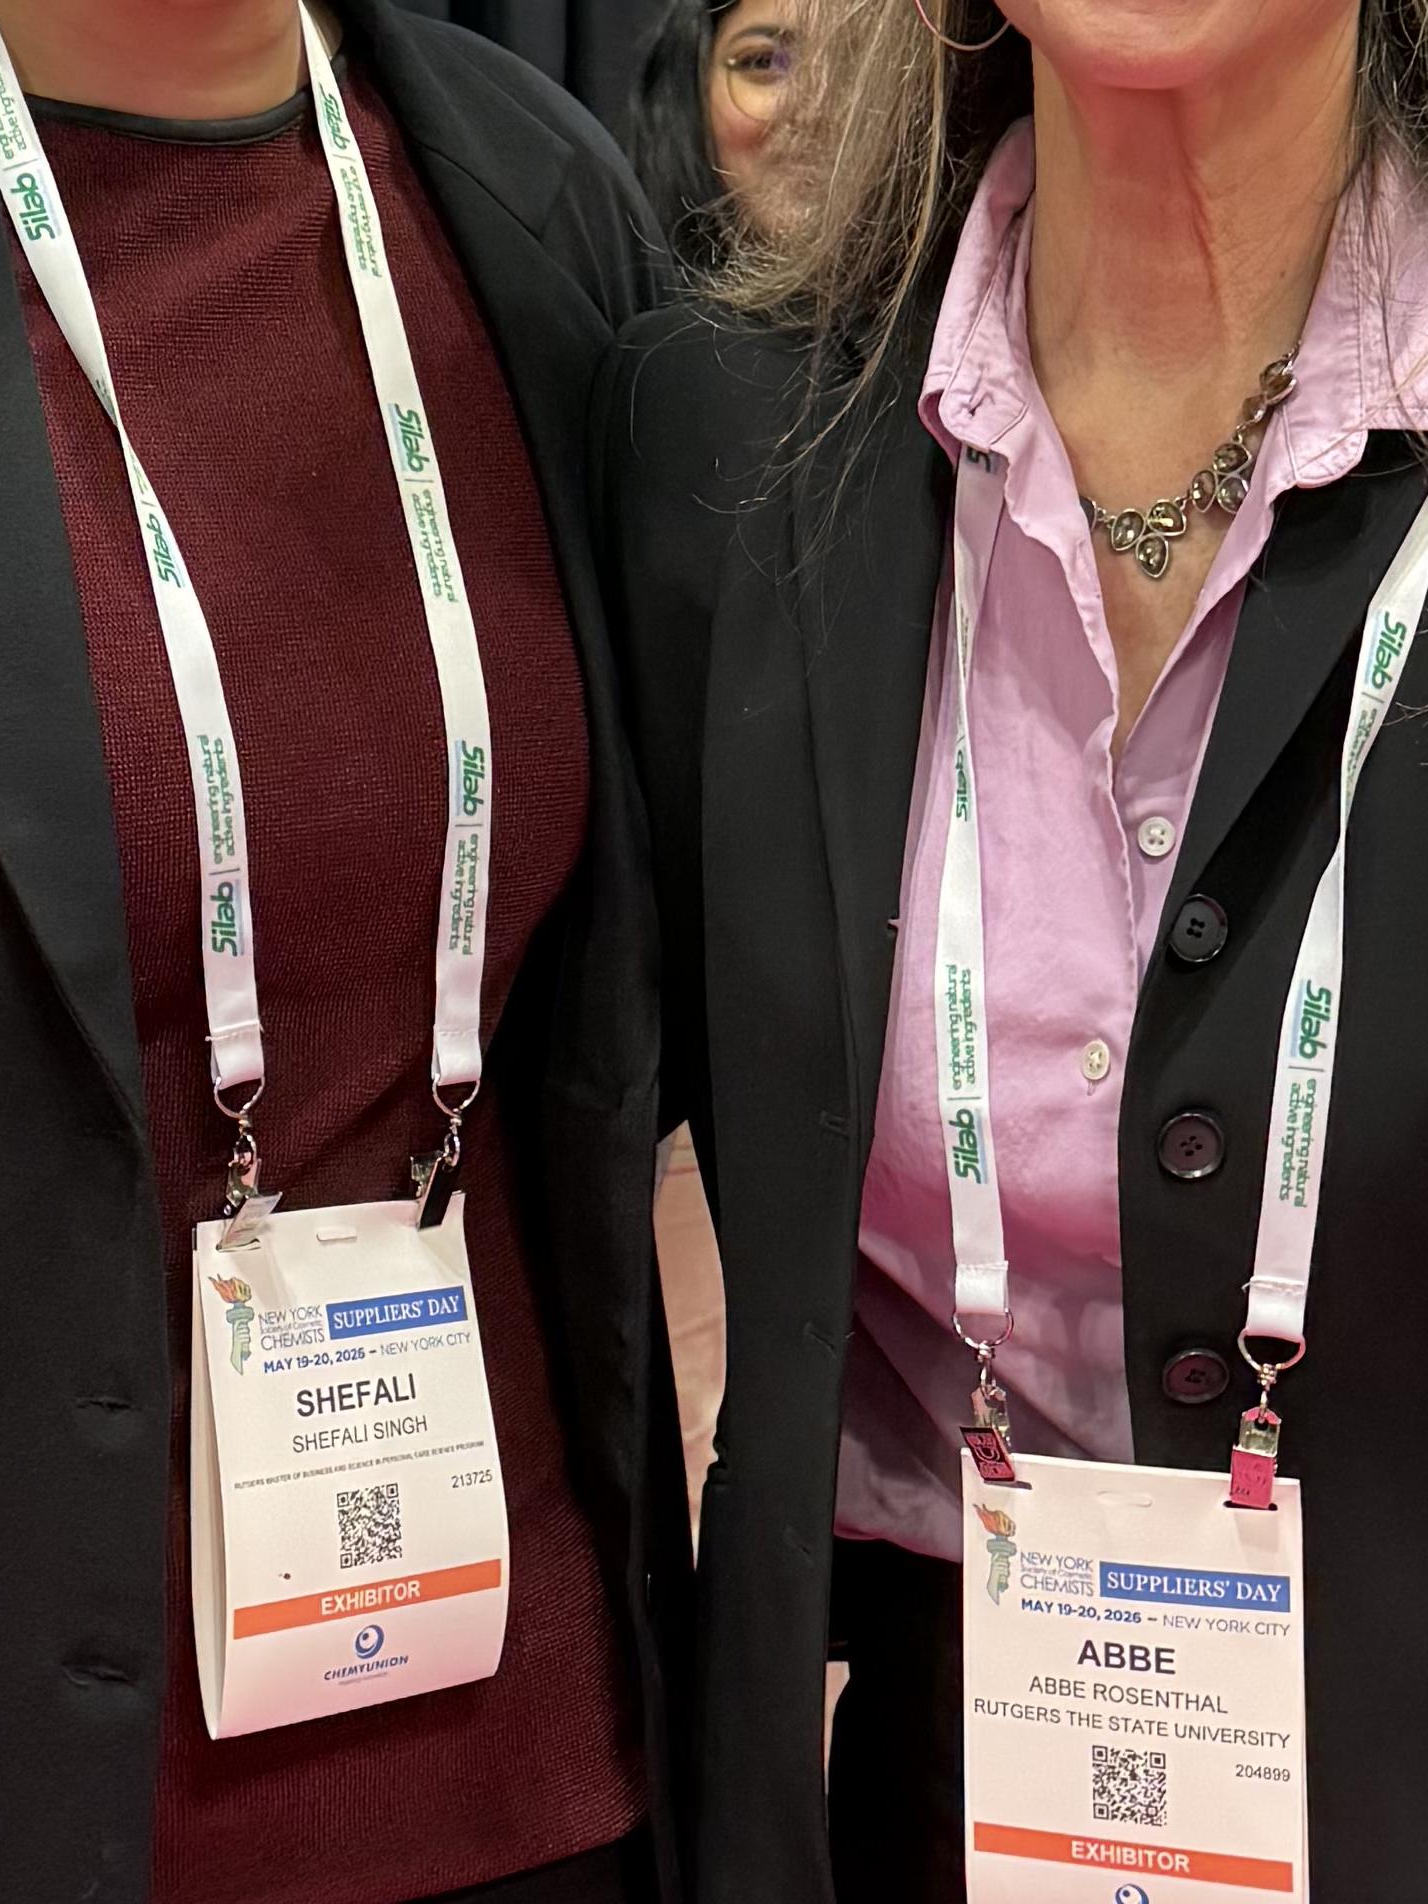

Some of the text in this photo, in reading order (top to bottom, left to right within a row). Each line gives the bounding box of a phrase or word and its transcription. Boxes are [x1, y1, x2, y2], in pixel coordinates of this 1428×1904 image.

[7, 116, 26, 152] active
[10, 172, 56, 242] Silab
[393, 402, 431, 474] Silab
[143, 514, 182, 589] Silab
[1369, 611, 1408, 691] Silab
[461, 738, 485, 817] Silab
[197, 734, 224, 865] engineering natural
[221, 816, 234, 857] active
[454, 839, 468, 878] active
[461, 833, 478, 957] engineering natural
[211, 881, 239, 958] Silab
[945, 964, 967, 1089] engineering natural
[958, 968, 976, 1084] active ingredients
[1299, 979, 1334, 1061] Silab
[952, 1107, 981, 1186] Silab
[1277, 1082, 1305, 1202] active ingredients
[1292, 1078, 1320, 1211] engineering natural
[258, 1304, 322, 1327] NEW YORK
[332, 1295, 460, 1330] SUPPLIERS' DAY
[261, 1328, 325, 1351] CHEMISTS
[264, 1358, 293, 1374] MAY
[296, 1351, 334, 1369] 19-20,
[380, 1342, 409, 1356] NEW
[410, 1335, 443, 1352] YORK
[446, 1332, 471, 1347] CITY
[297, 1373, 416, 1417] SHEFALI
[292, 1415, 428, 1453] SHEFALI SINGH
[451, 1469, 493, 1489] 213725
[1020, 1552, 1094, 1572] NEW YORK
[320, 1580, 421, 1616] EXHIBITOR
[1020, 1574, 1094, 1597] CHEMISTS
[1107, 1571, 1281, 1603] SUPPLIERS' DAY
[1021, 1598, 1054, 1612] MAY
[1057, 1604, 1101, 1622] 19-20,
[1103, 1609, 1142, 1624] 2026
[1162, 1614, 1202, 1630] NEW
[1204, 1616, 1250, 1634] YORK
[1254, 1621, 1291, 1637] CITY
[324, 1655, 409, 1681] CHEMYUNION
[1076, 1639, 1176, 1675] ABBE
[1029, 1675, 1229, 1714] ABBE ROSENTHAL
[974, 1697, 1291, 1749] RUTGERS THE STATE UNIVERSITY
[1071, 1840, 1190, 1873] EXHIBITOR
